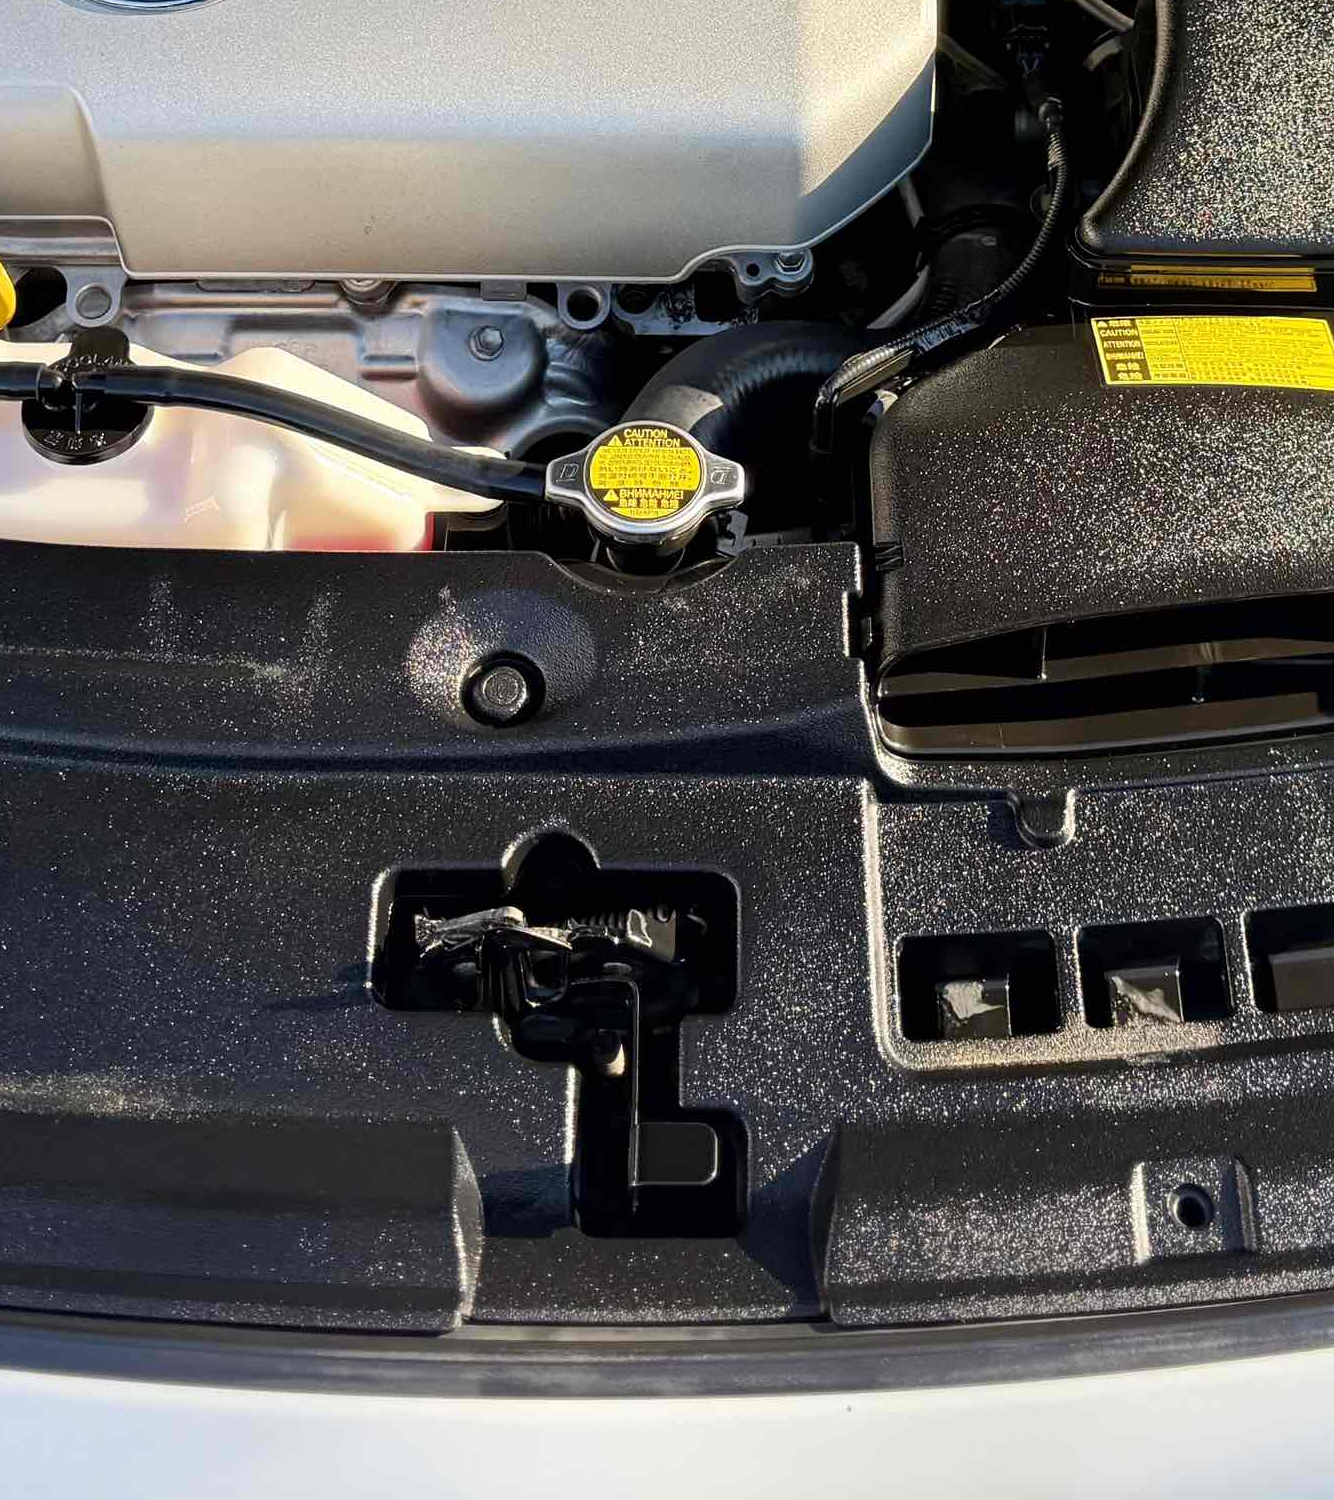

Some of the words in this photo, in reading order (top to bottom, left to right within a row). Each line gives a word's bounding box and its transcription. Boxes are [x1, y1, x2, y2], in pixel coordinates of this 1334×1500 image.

[1099, 329, 1139, 337] CAUTION
[1103, 339, 1142, 348] ATTENTION
[623, 428, 668, 438] CAUTION
[623, 438, 681, 448] ATTENTION
